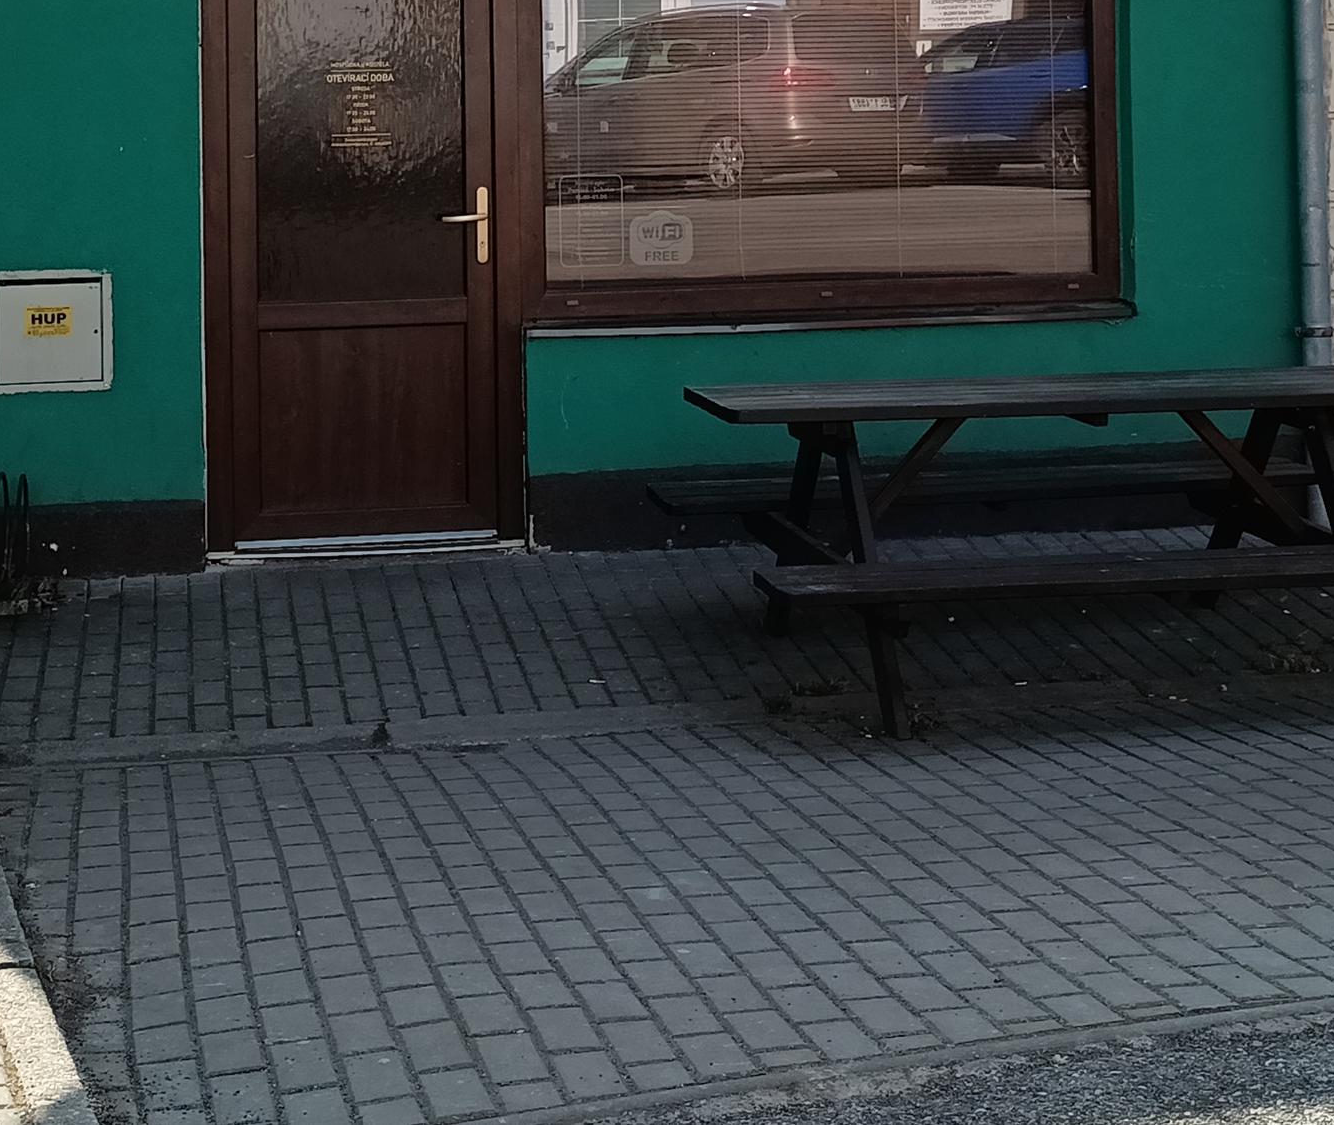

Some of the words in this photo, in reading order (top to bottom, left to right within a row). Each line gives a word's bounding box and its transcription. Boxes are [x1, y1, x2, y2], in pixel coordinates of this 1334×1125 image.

[327, 72, 369, 83] OTEVÍRACÍ
[370, 73, 395, 82] DOBA
[645, 251, 679, 262] FREE
[31, 312, 67, 325] HUP
